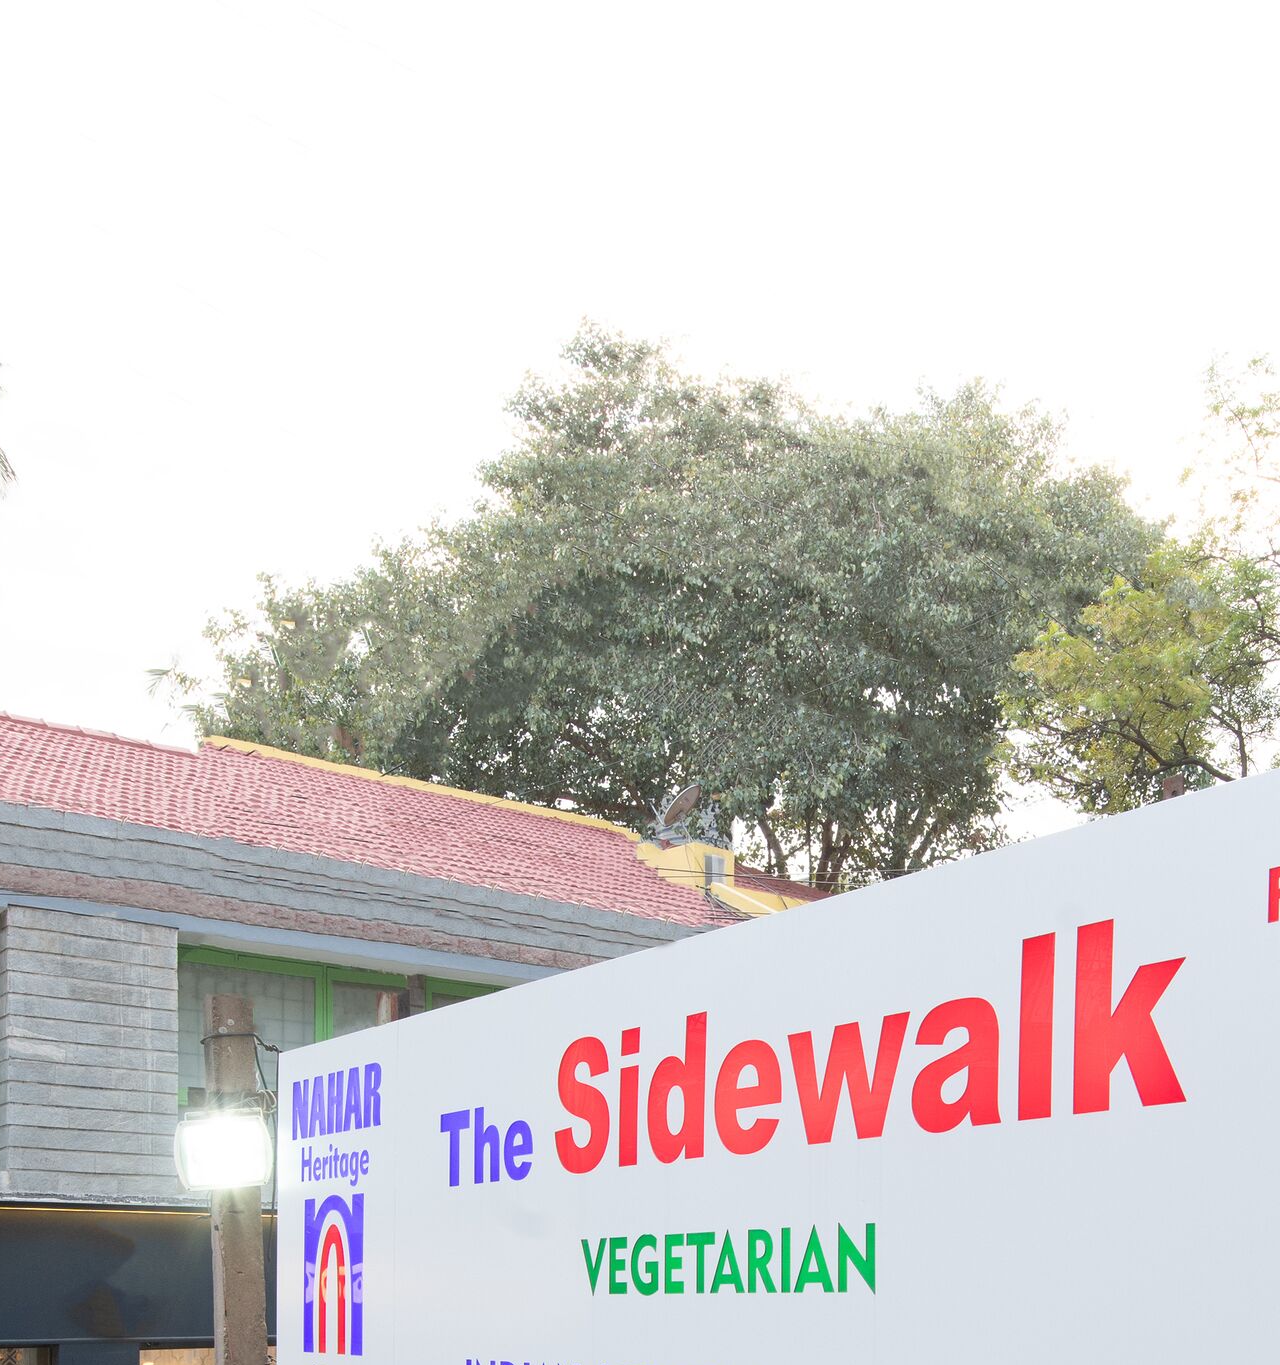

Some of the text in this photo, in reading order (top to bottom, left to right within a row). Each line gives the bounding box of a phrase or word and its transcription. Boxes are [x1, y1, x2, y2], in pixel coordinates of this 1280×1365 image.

[439, 918, 1187, 1188] The Sidewalk
[292, 1062, 382, 1141] NAHAR
[301, 1145, 370, 1188] Heritage
[581, 1222, 877, 1297] VEGETARIAN
